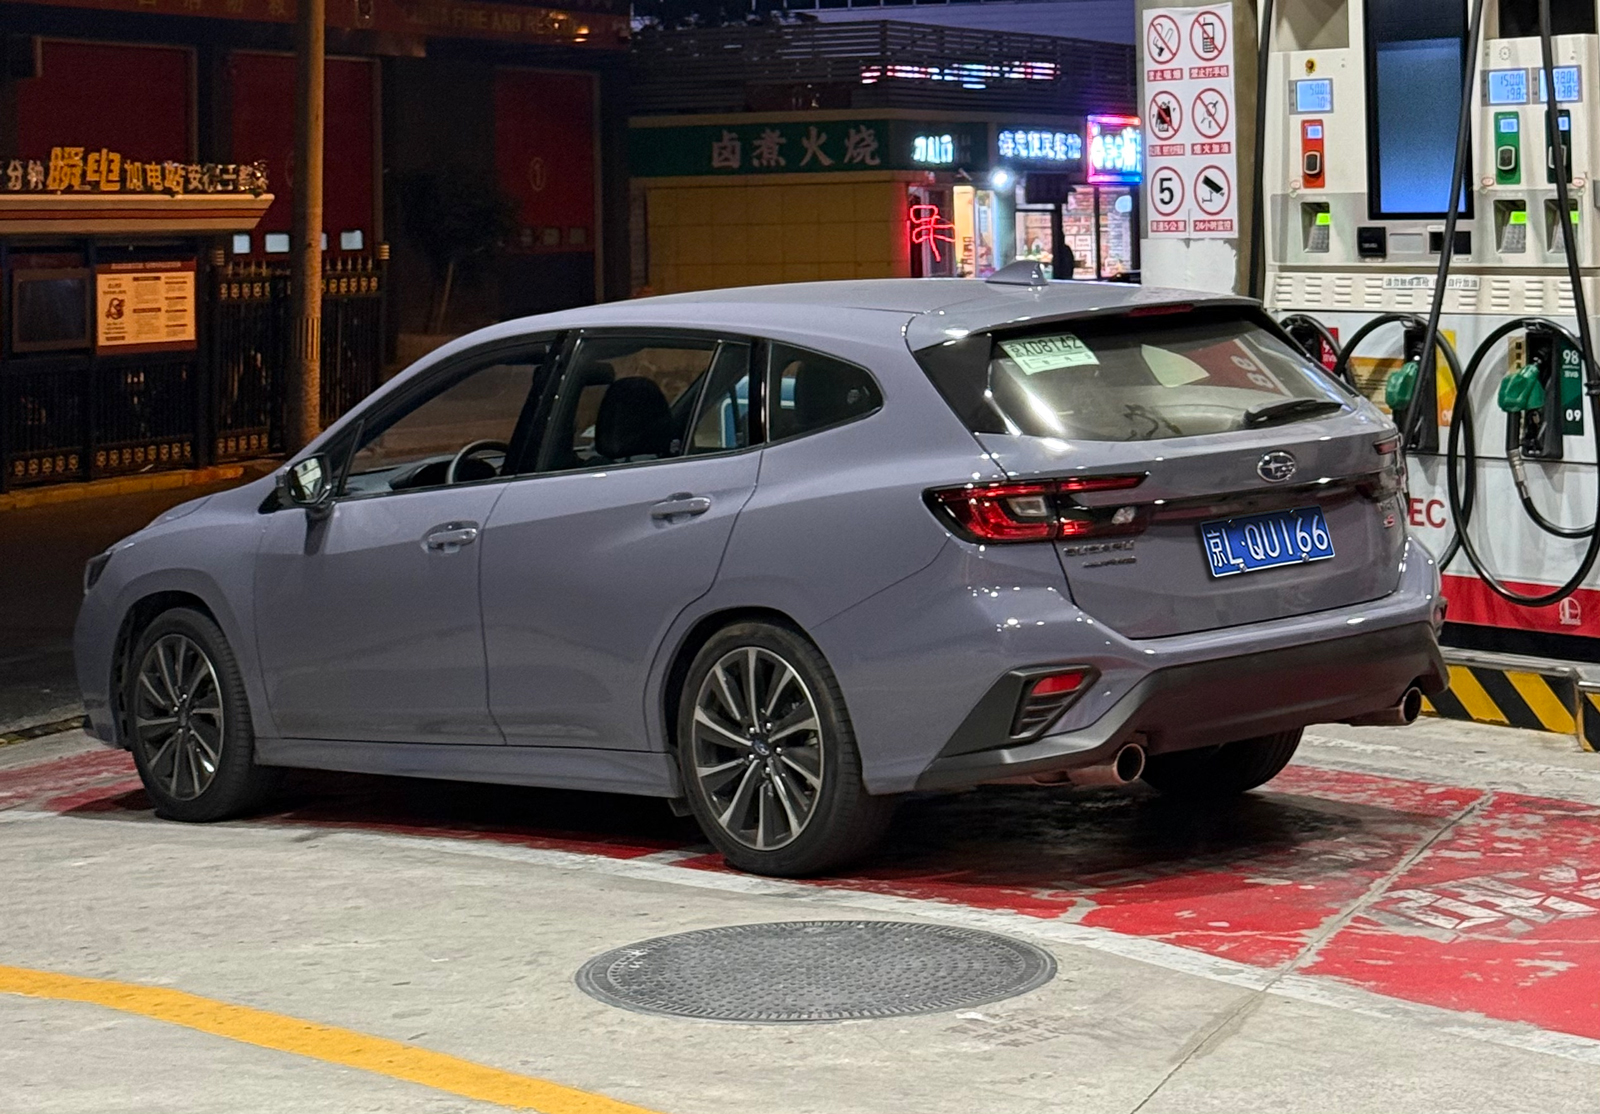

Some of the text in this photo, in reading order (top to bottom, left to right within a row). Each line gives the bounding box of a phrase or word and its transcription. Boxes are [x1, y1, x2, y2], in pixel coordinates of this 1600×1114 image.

[711, 125, 881, 169] 卤煮火烧
[1158, 177, 1174, 206] 5
[1562, 349, 1580, 365] 98
[1565, 409, 1582, 422] 09
